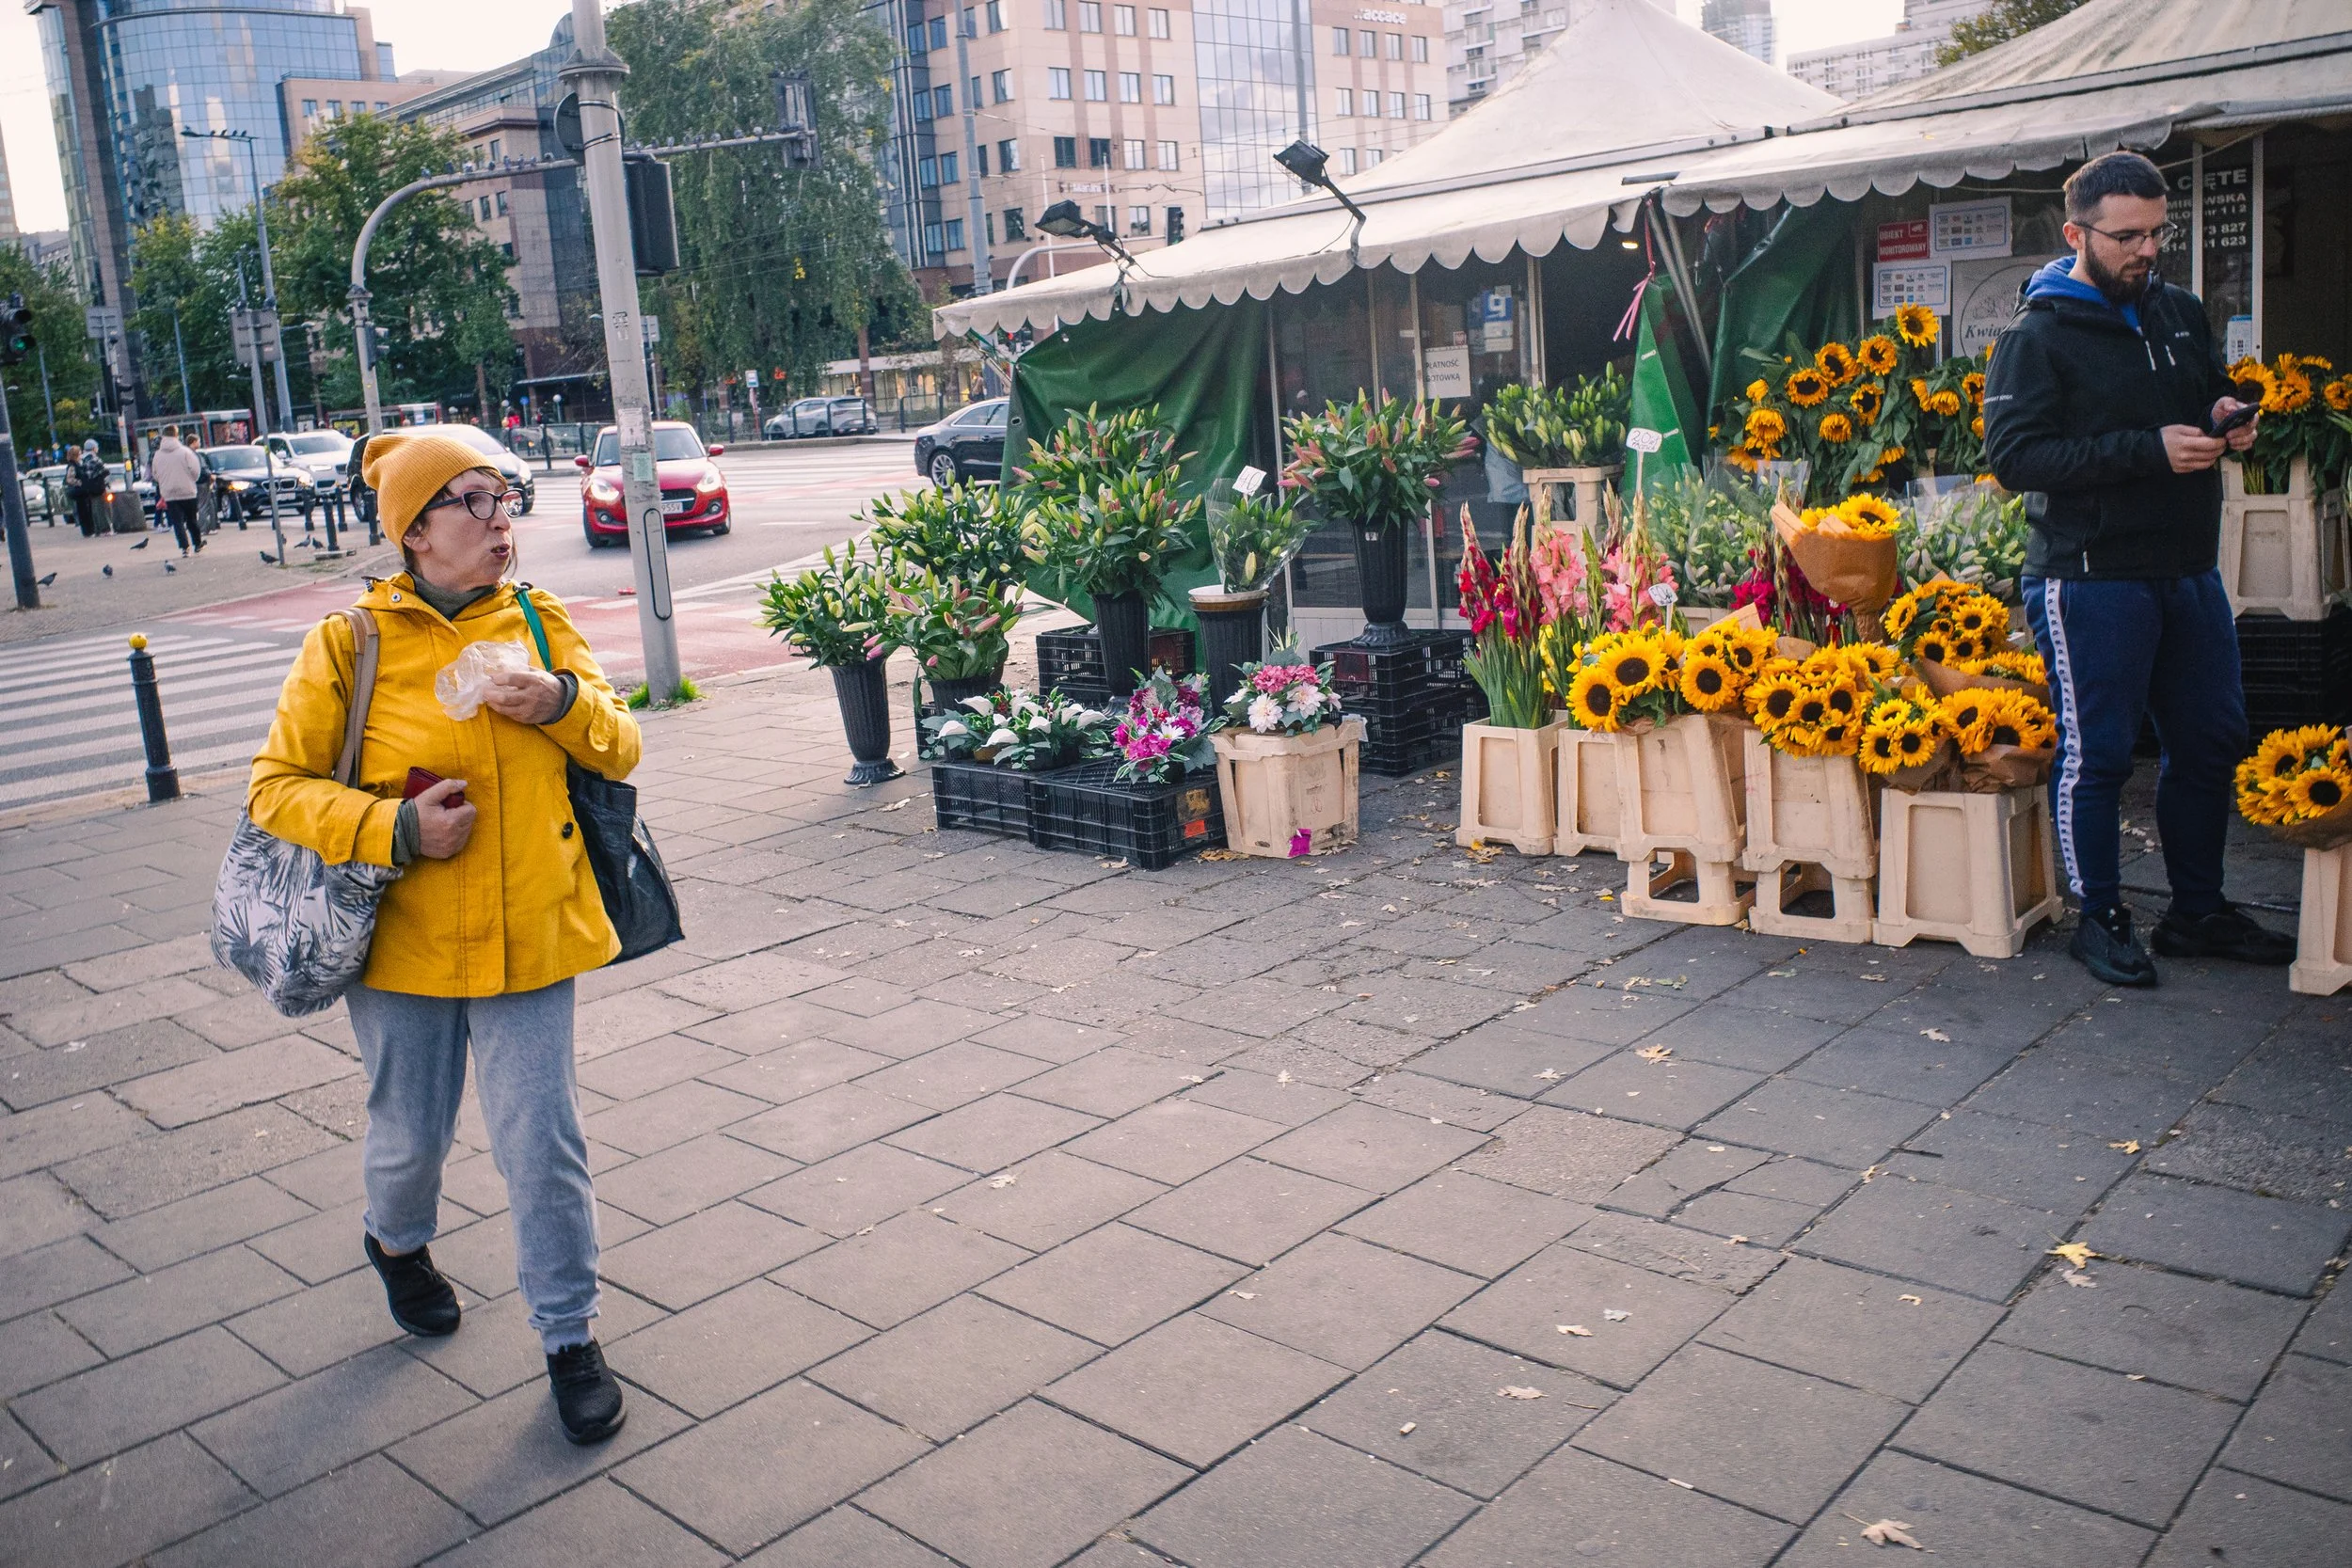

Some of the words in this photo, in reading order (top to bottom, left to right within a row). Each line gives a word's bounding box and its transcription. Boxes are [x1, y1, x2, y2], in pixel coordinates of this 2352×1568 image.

[2177, 169, 2248, 191] CĘTE
[2167, 193, 2247, 210] MIRWSKA
[1880, 242, 1927, 256] MONITOROWANY
